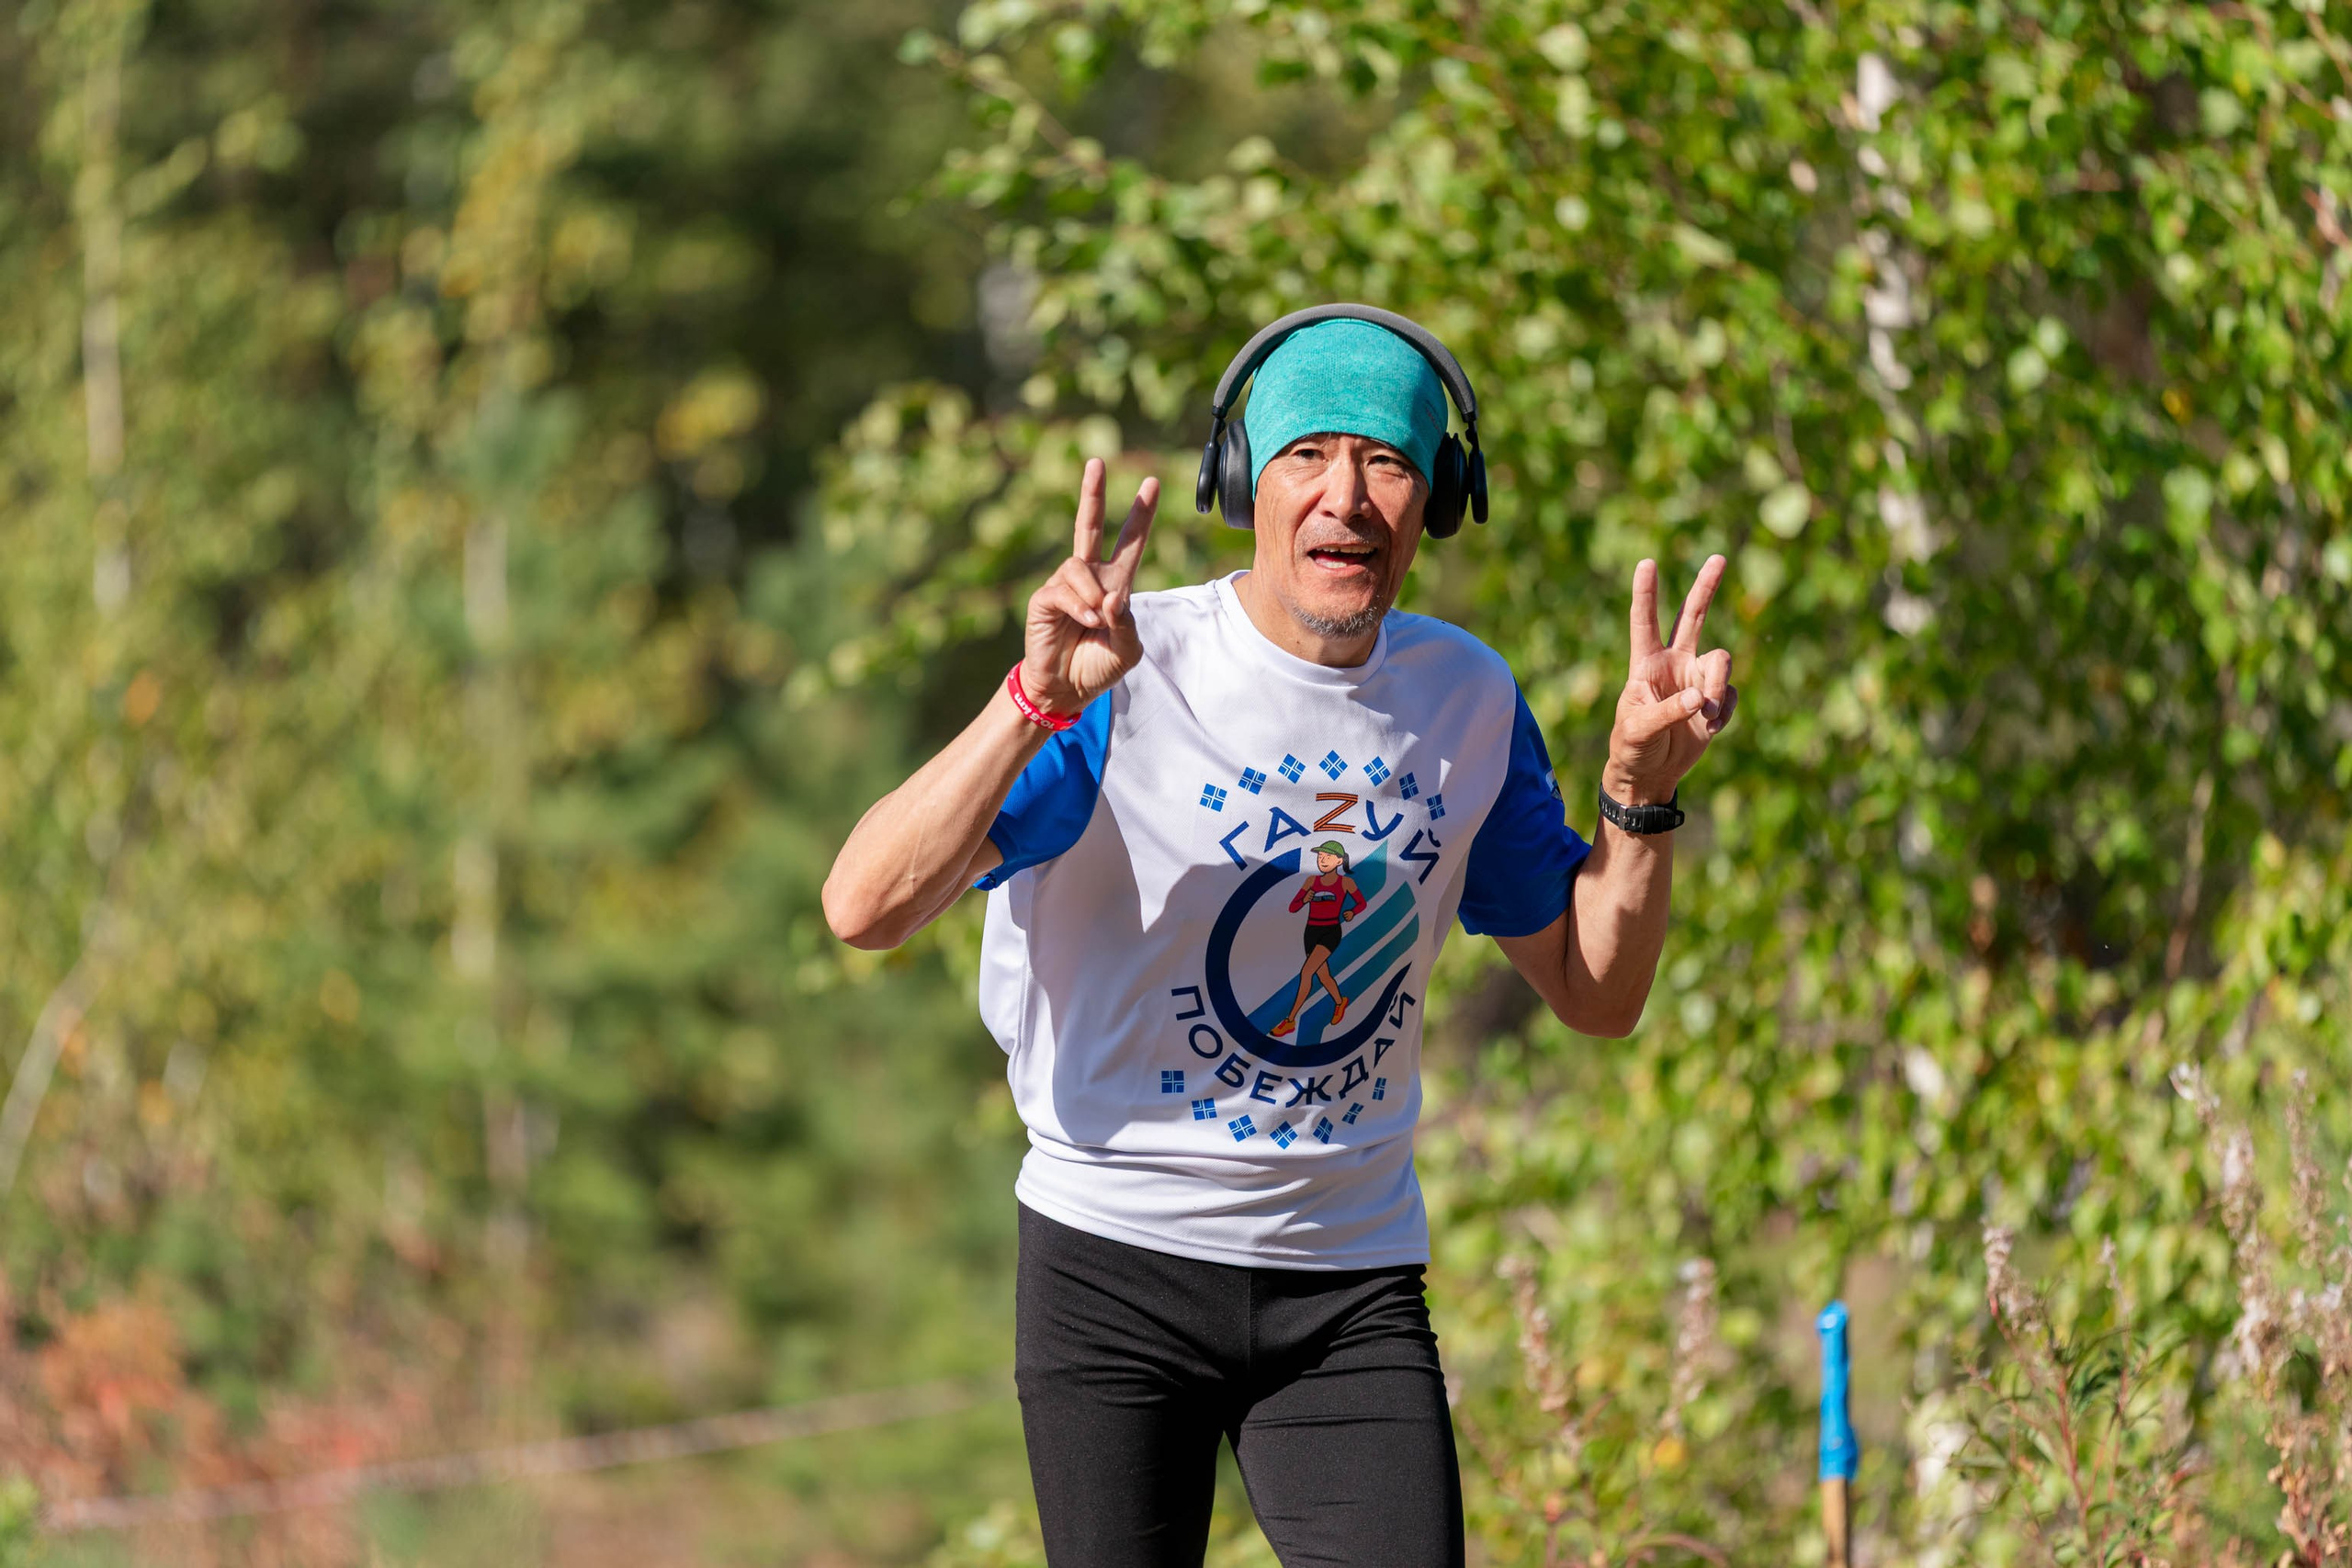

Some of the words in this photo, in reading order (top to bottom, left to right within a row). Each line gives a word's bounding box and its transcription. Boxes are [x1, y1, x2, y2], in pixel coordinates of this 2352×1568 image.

[1014, 693, 1032, 715] km
[1030, 712, 1055, 729] 10.5
[1171, 986, 1416, 1108] ПОБЕЖДАЙ
